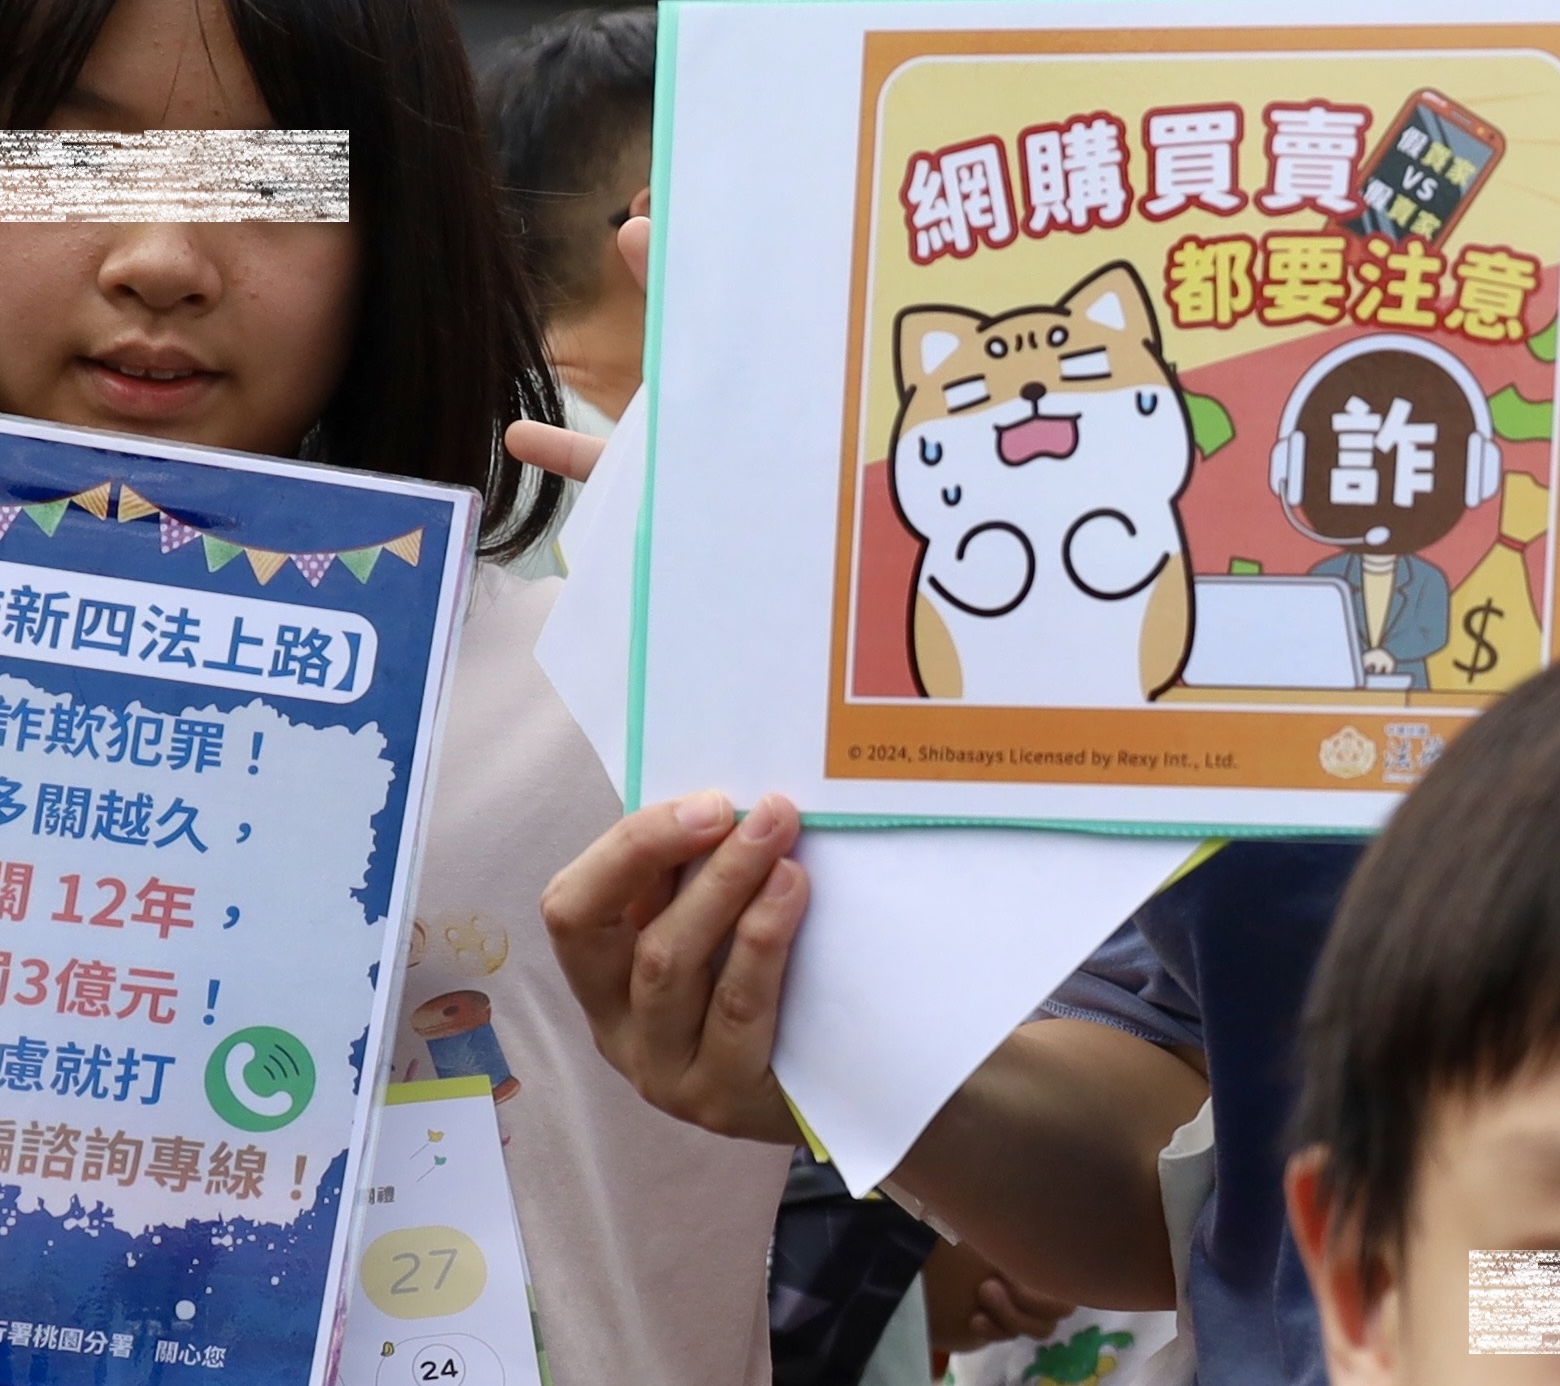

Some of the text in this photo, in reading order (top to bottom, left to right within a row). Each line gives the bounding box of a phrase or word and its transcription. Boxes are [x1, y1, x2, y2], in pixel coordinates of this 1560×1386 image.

[903, 103, 1368, 261] 網購買賣
[1401, 164, 1439, 202] VS
[1167, 234, 1541, 344] 都要注意
[1329, 394, 1439, 509] 詐
[866, 744, 913, 765] 2024,
[917, 744, 1005, 767] Shibasays
[1008, 747, 1086, 767] Licensed
[1090, 749, 1113, 769] by
[1116, 749, 1159, 770] Rexy
[1204, 752, 1240, 771] Ltd.
[389, 1248, 459, 1296] 27
[154, 1339, 228, 1370] 關心您
[419, 1358, 459, 1382] 24
